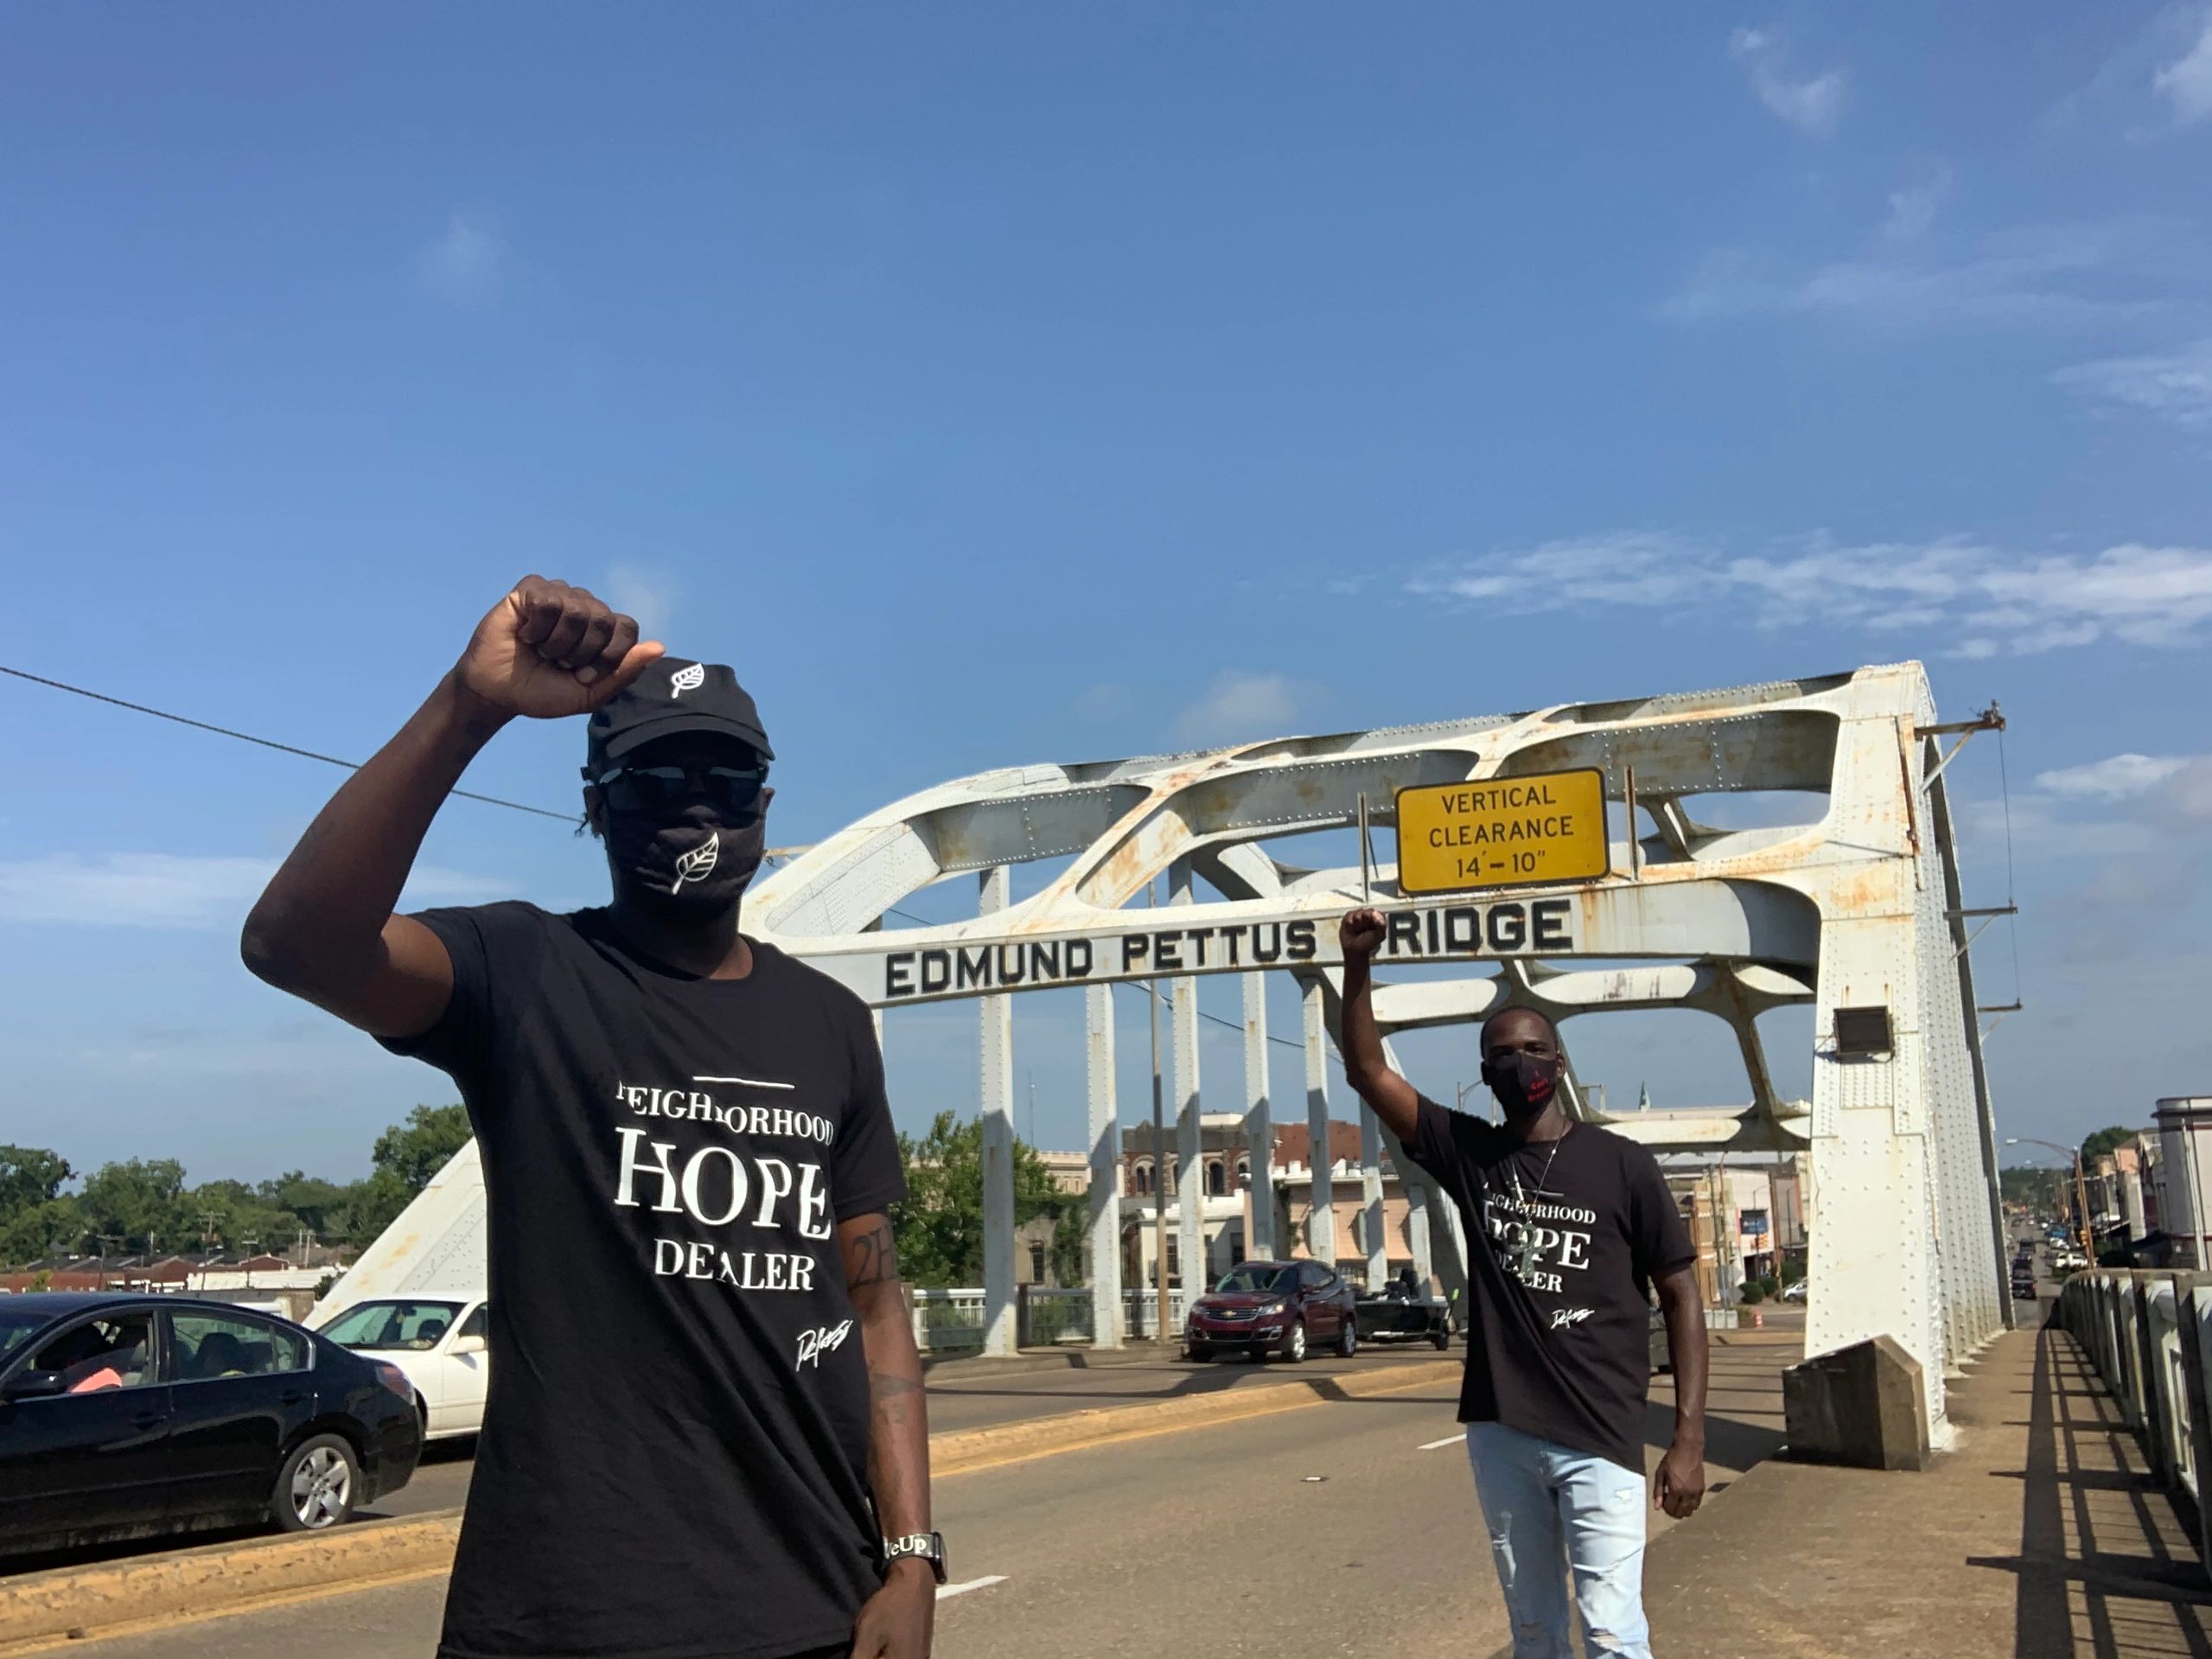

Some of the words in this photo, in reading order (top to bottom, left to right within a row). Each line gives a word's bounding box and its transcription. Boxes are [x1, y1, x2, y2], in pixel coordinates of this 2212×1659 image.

[1442, 785, 1557, 814] VERTICAL
[1429, 816, 1574, 848] CLEARANCE
[886, 938, 1094, 998] EDMUND
[1122, 920, 1317, 973] PETTUS
[1374, 899, 1573, 955] RIDGE
[613, 1126, 832, 1241] HOPE
[653, 1238, 816, 1292] DEALER
